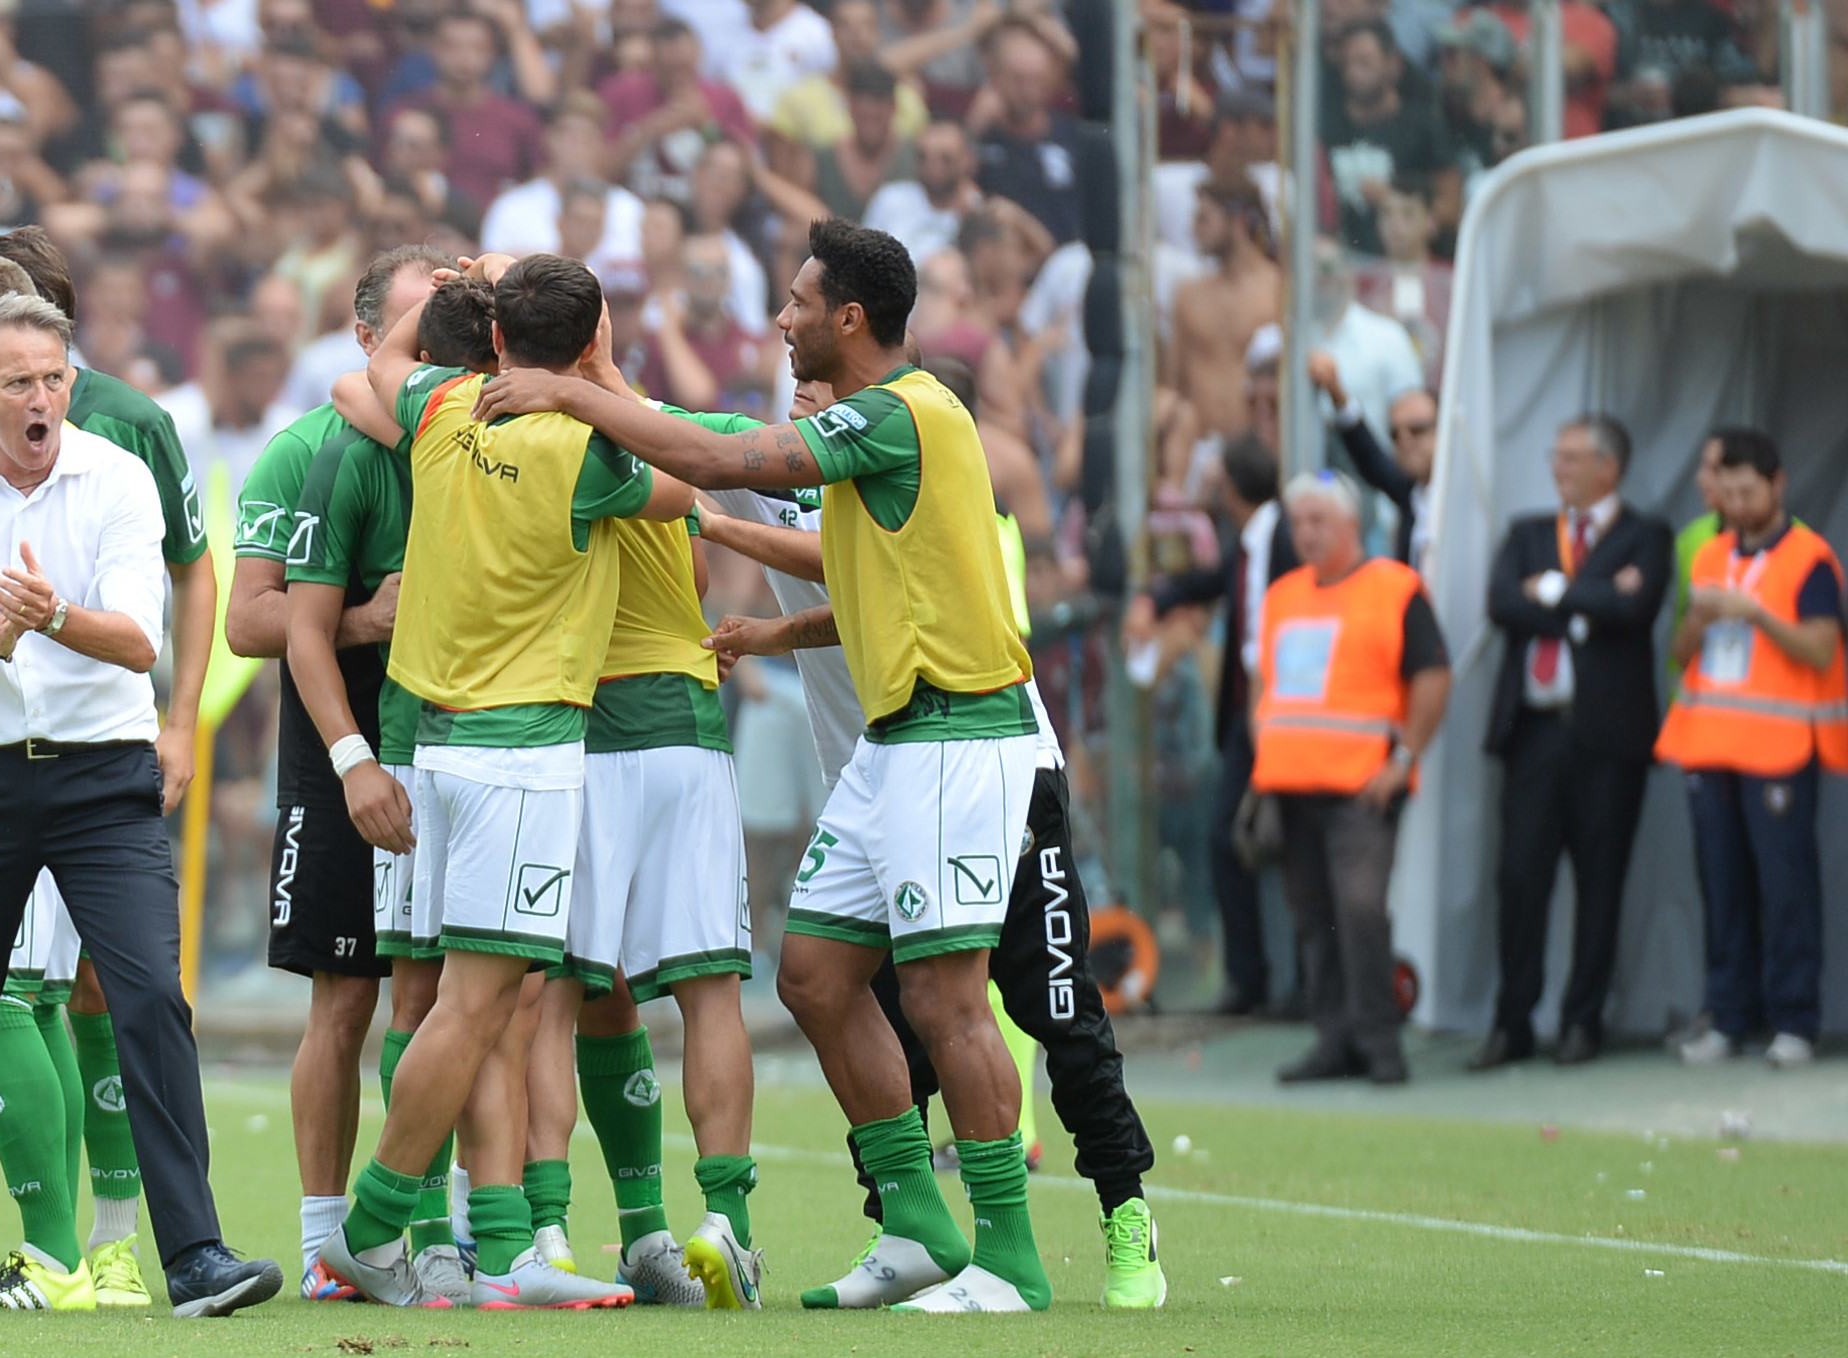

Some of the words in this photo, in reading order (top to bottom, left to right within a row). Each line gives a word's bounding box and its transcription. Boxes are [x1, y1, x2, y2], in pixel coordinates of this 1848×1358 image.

[778, 507, 798, 528] 42
[272, 805, 305, 927] GIVOVA
[797, 826, 840, 883] 5
[334, 936, 358, 958] 37
[1039, 846, 1075, 1020] GIVOVA
